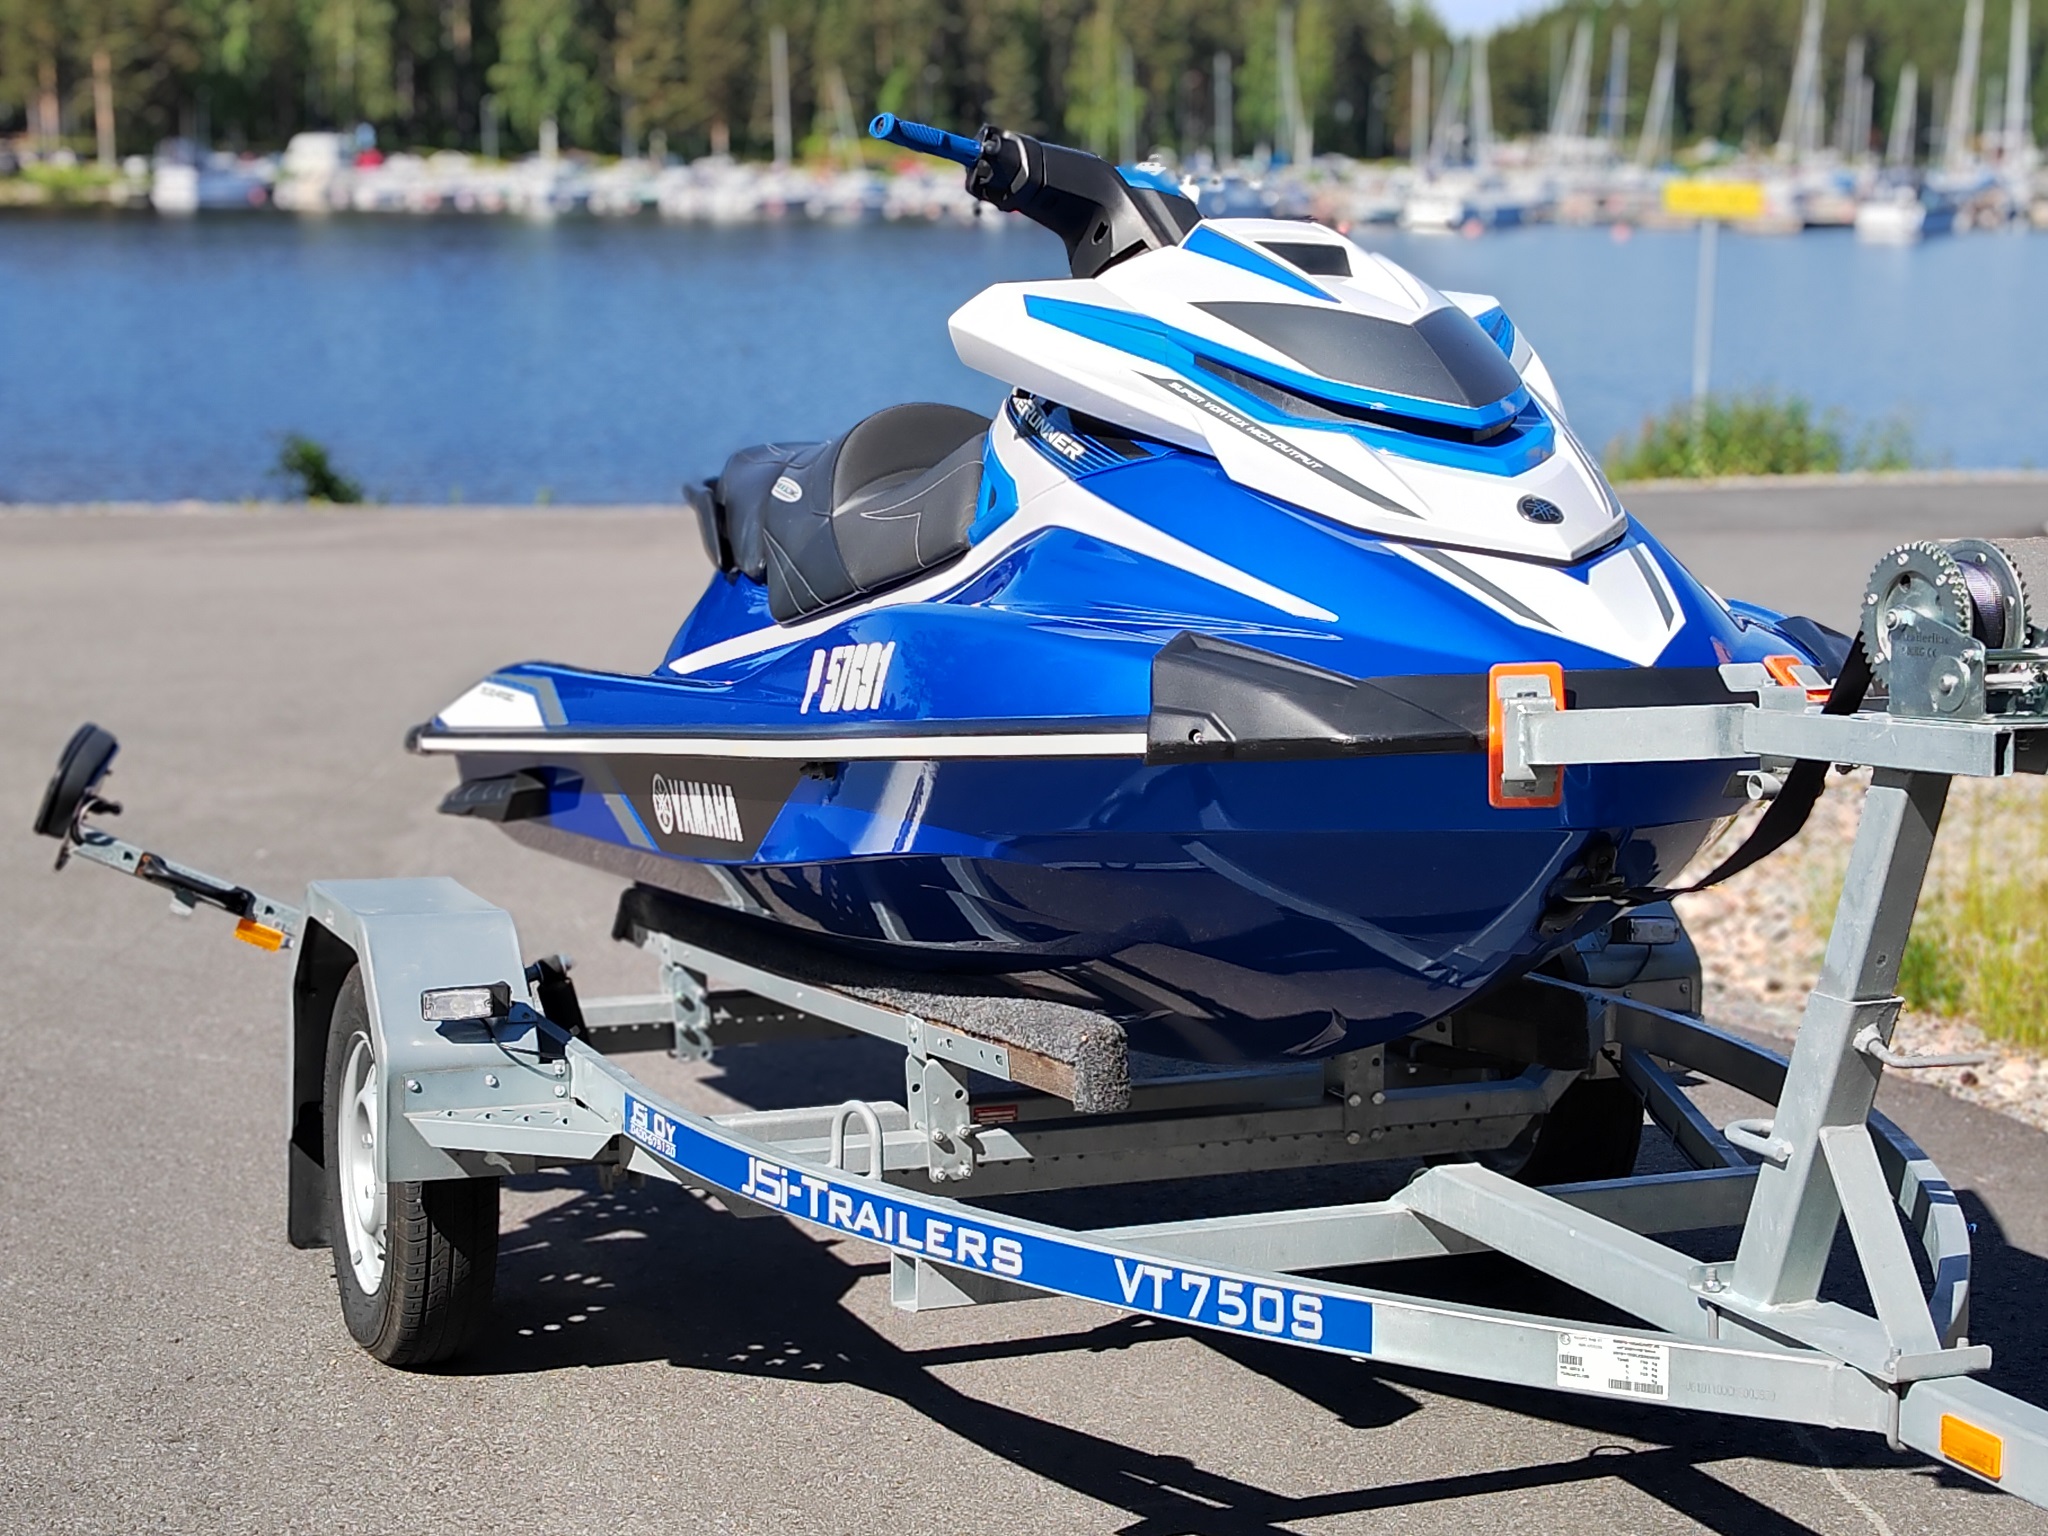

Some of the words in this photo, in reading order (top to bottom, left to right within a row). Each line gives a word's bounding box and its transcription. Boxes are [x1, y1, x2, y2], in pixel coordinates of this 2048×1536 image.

[1168, 381, 1206, 404] SUPER
[1204, 400, 1249, 428] VORTEX
[1246, 424, 1276, 443] HIGH
[1273, 441, 1324, 470] OUTPUT
[667, 778, 744, 843] YAMAHA
